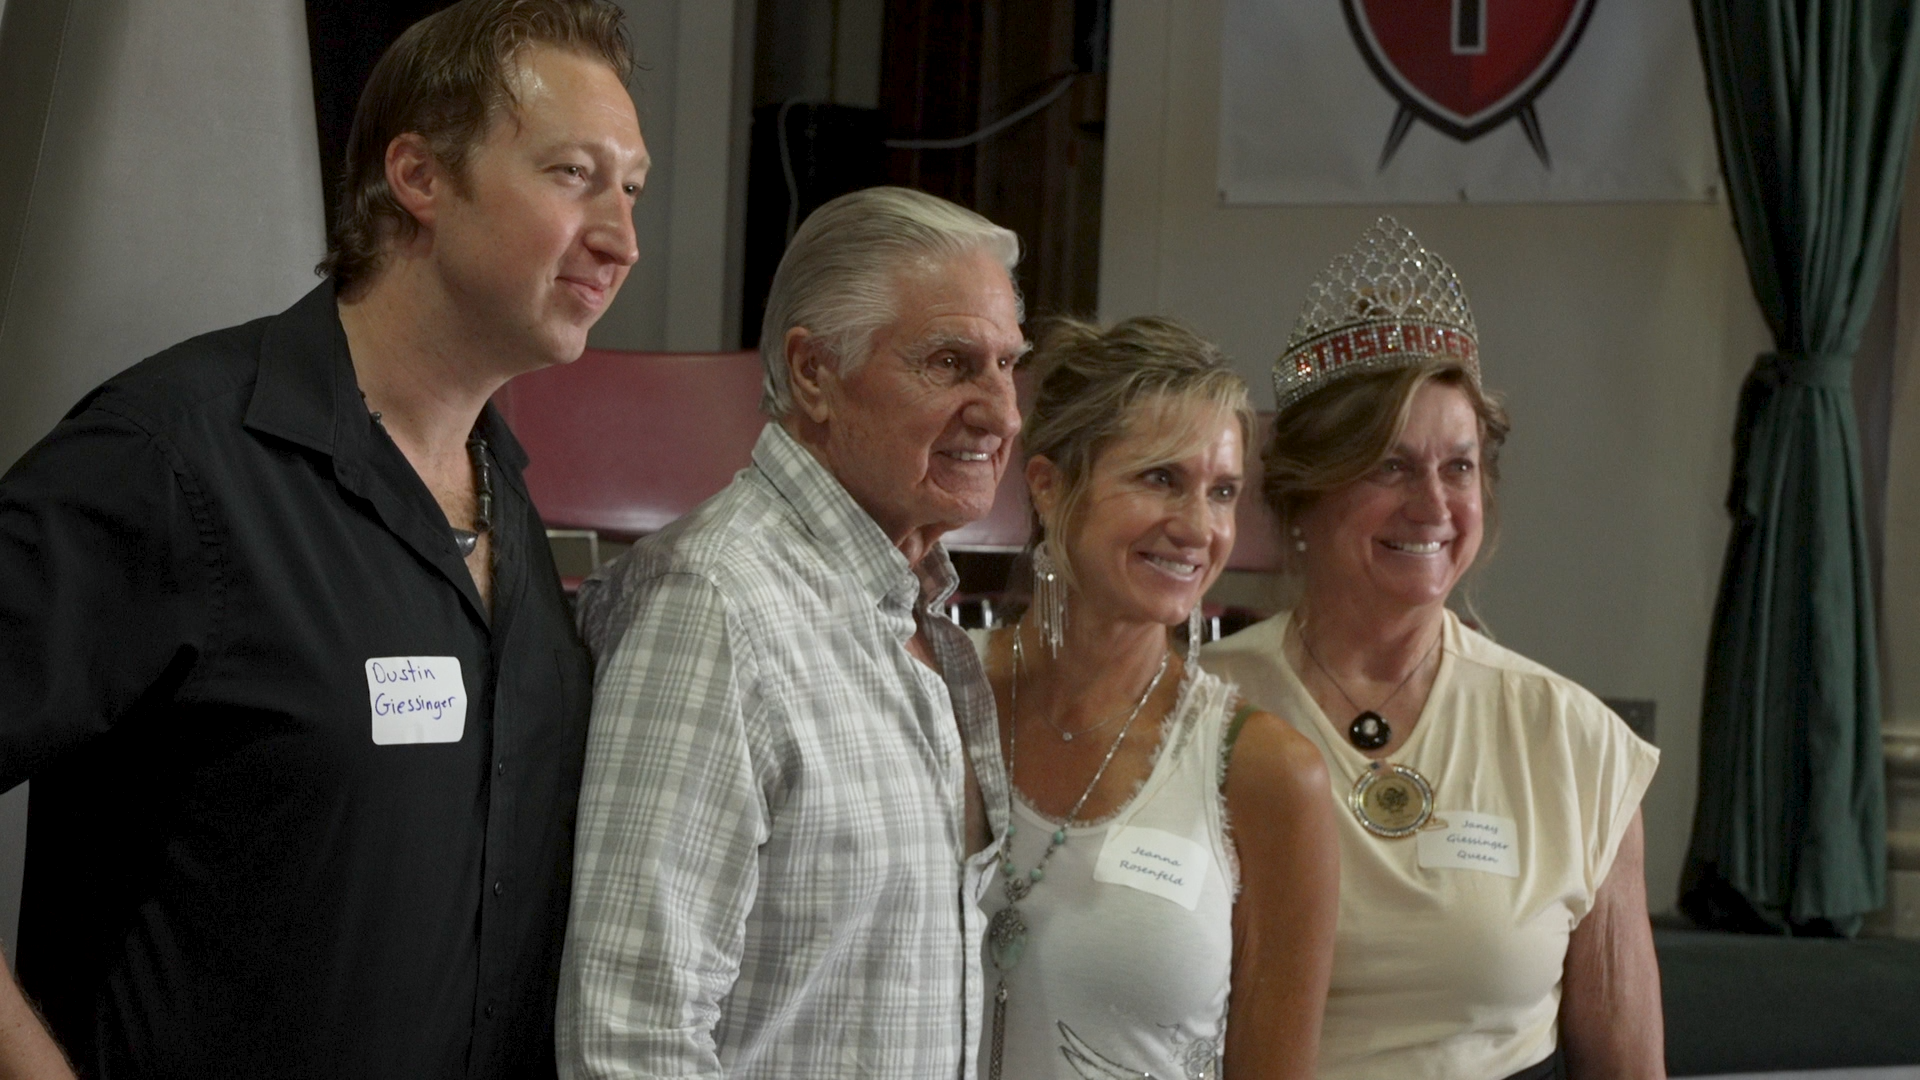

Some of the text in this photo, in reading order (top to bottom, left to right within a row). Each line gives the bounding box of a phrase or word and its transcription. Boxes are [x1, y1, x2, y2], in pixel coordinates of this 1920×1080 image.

[1295, 323, 1473, 380] ATASCADER
[372, 659, 436, 684] Dustin
[375, 693, 457, 720] Giessinger
[1463, 820, 1499, 835] Janey
[1446, 833, 1509, 850] Giessinger
[1130, 846, 1183, 867] Jeanna
[1457, 850, 1500, 863] Queen
[1119, 860, 1185, 886] Rosenfeld
